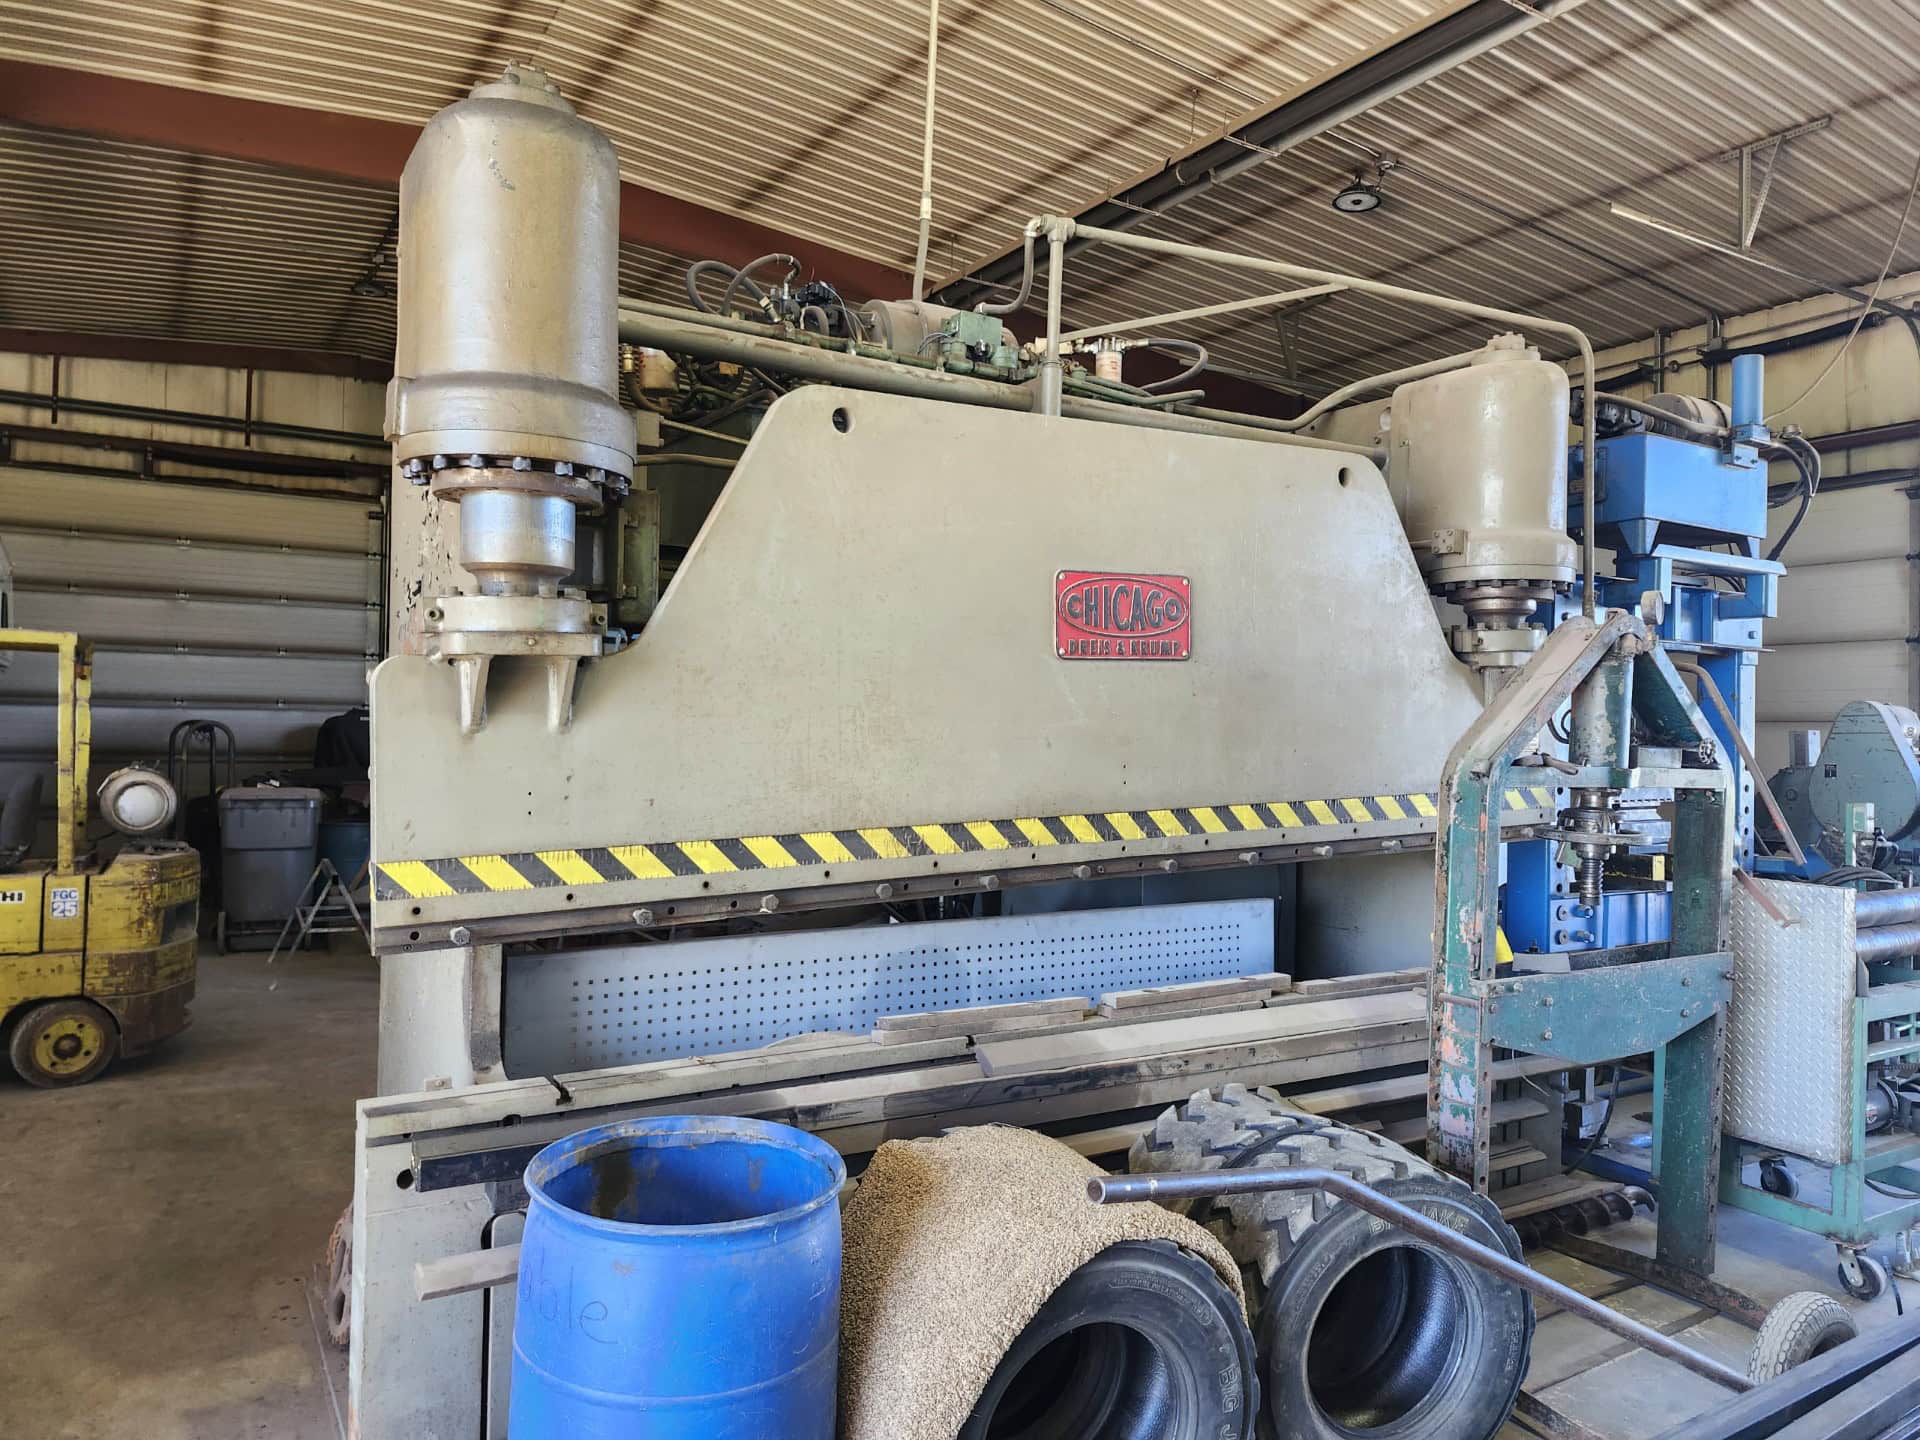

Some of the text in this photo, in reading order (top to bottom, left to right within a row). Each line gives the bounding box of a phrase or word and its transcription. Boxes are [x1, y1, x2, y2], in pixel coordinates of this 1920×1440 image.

[1066, 583, 1182, 632] CHICAGO
[1068, 638, 1111, 656] DREIS
[1117, 639, 1125, 656] &
[0, 891, 23, 902] HI
[53, 889, 78, 899] FGC
[52, 901, 78, 917] 25
[1219, 1363, 1240, 1414] BIG
